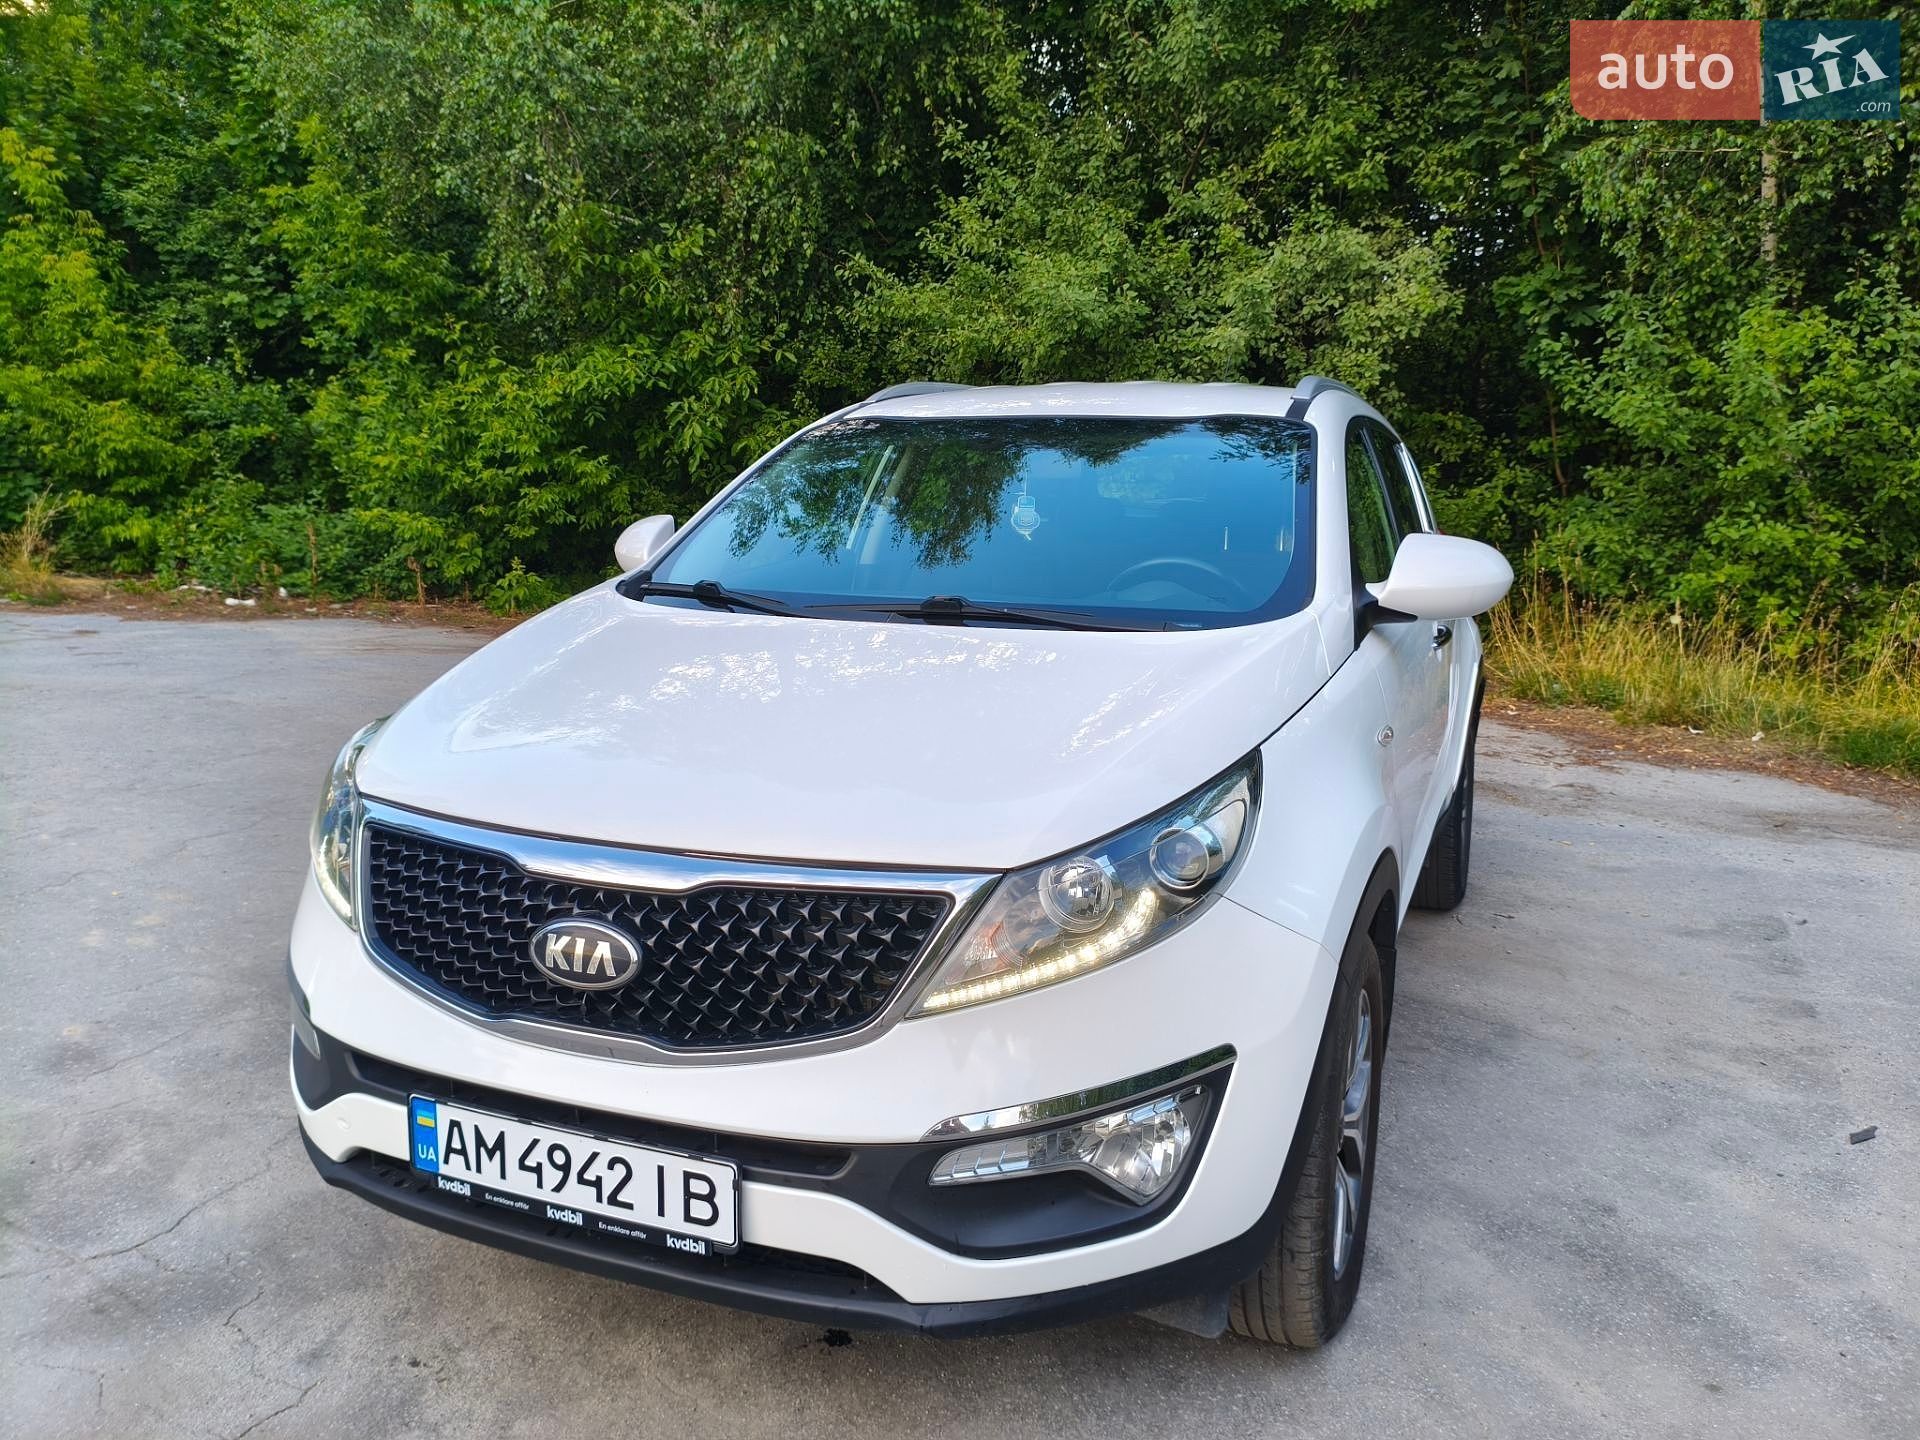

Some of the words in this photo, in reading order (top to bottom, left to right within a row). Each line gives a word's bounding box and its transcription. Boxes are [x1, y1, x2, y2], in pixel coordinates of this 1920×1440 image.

[545, 933, 617, 977] KIA
[418, 1144, 437, 1162] UA
[443, 1118, 506, 1180] AM
[518, 1137, 634, 1211] 4942
[657, 1163, 720, 1227] IB
[438, 1176, 471, 1196] kvdbil
[546, 1205, 583, 1226] kvdbil
[598, 1221, 607, 1230] En
[666, 1234, 706, 1255] kvdbil
